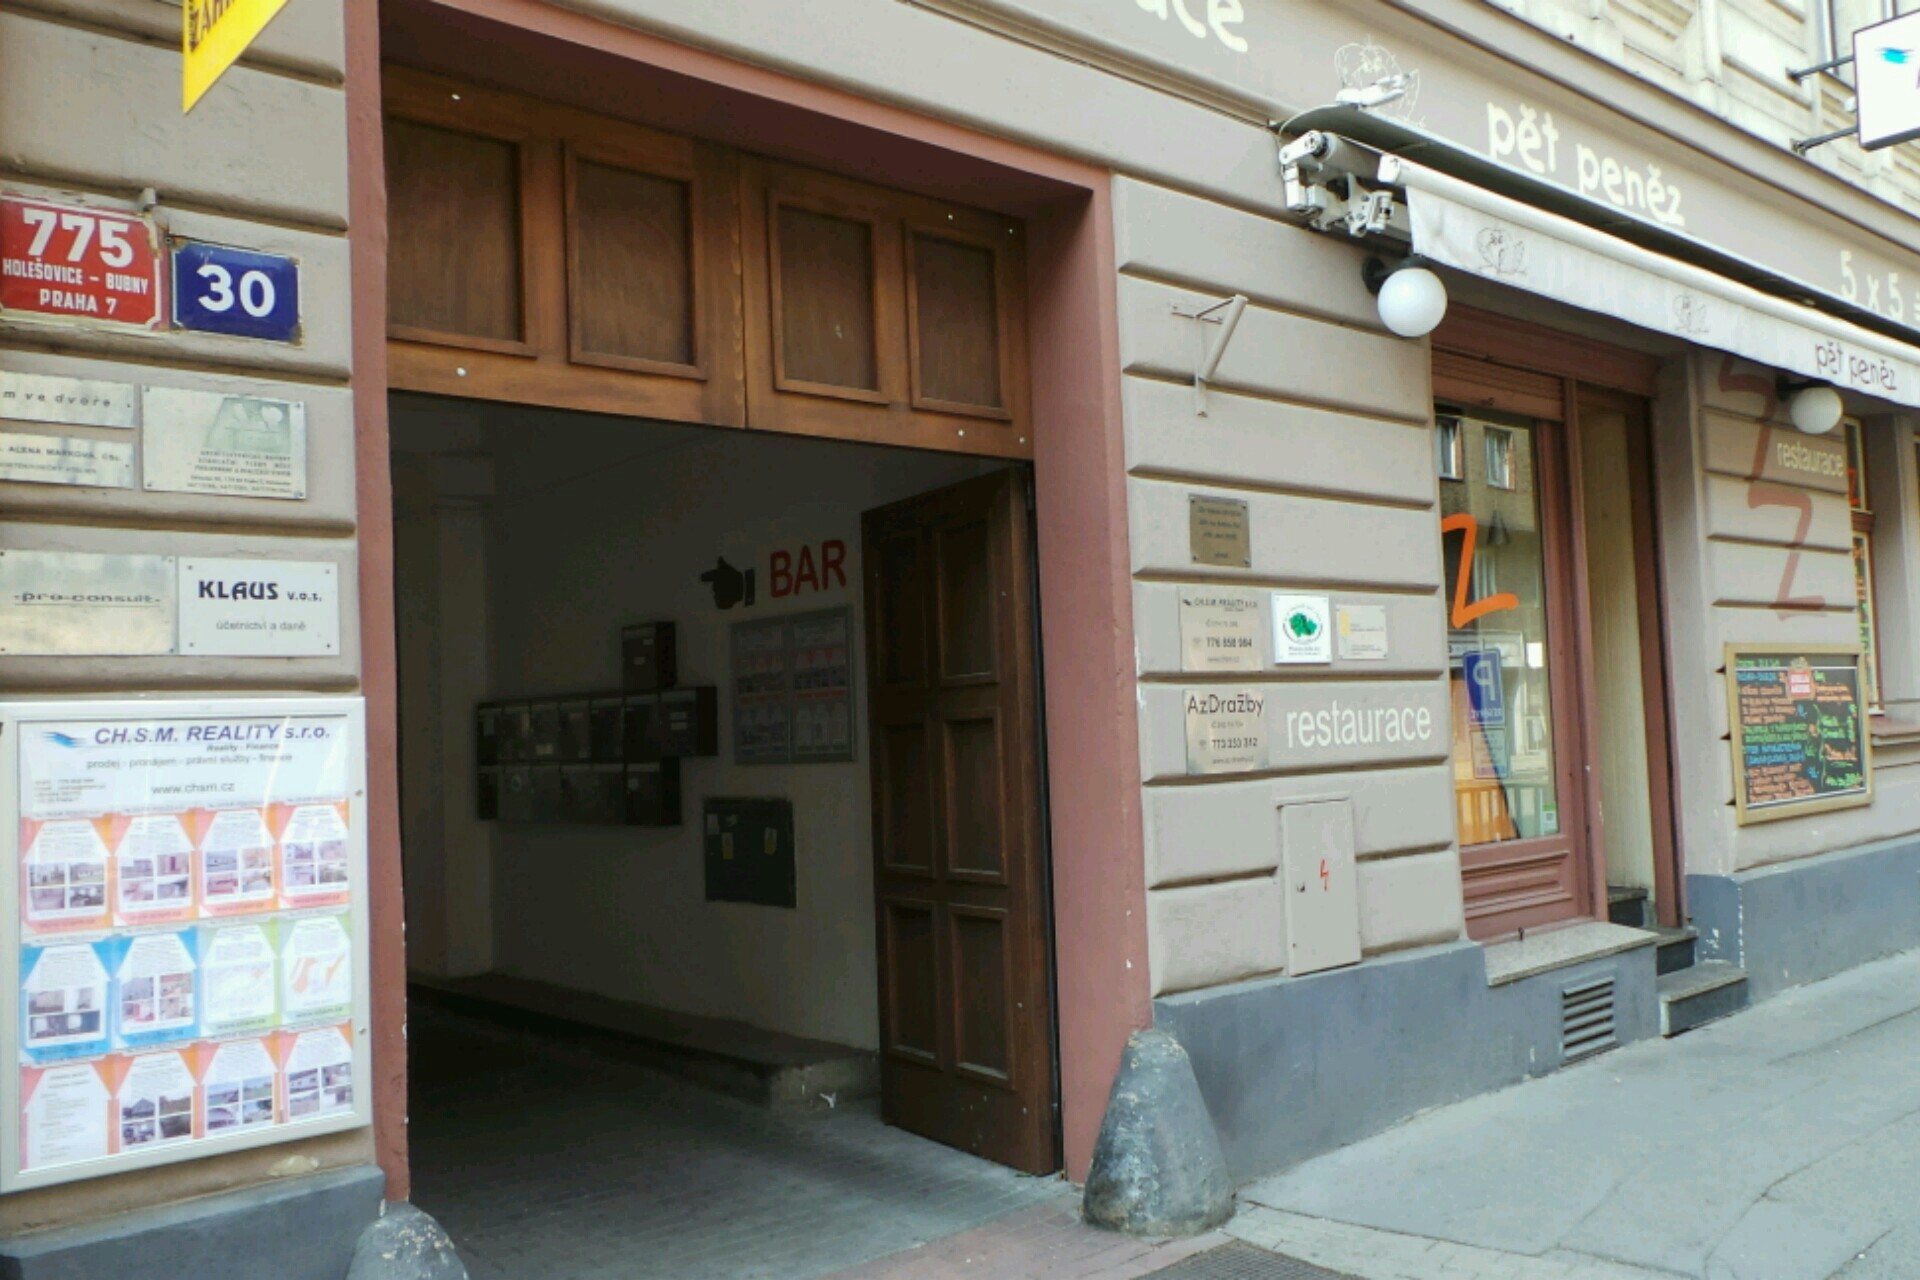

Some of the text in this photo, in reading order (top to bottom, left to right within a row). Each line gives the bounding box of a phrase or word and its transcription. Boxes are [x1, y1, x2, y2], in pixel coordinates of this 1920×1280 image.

[1486, 101, 1560, 174] pět
[22, 207, 134, 268] 775
[2, 257, 84, 286] HOLEŠOVICE
[105, 271, 149, 295] BUBNY
[196, 264, 276, 318] 30
[39, 288, 117, 315] PRAHA 7
[1776, 440, 1844, 478] restaurace
[770, 539, 847, 599] BAR
[198, 580, 279, 601] KLAUS
[1187, 693, 1264, 716] AzDražby
[94, 723, 331, 745] CH.S.M. REALITY s.r.o.
[1286, 700, 1432, 748] restaurace
[87, 759, 121, 770] prodej
[151, 782, 236, 795] www.chsm.cz
